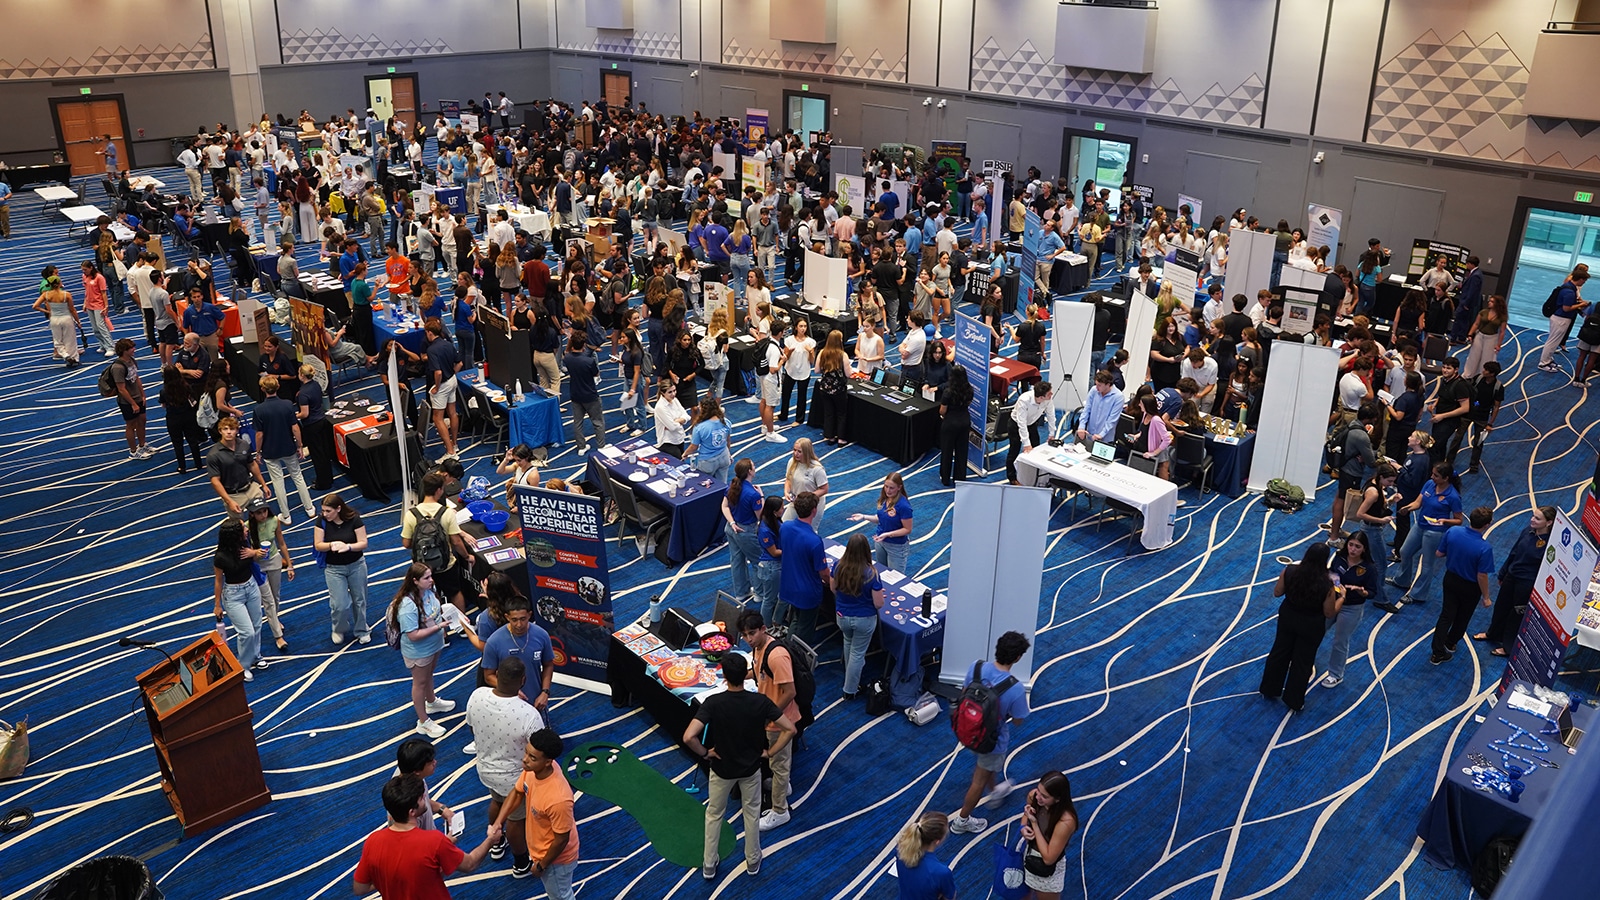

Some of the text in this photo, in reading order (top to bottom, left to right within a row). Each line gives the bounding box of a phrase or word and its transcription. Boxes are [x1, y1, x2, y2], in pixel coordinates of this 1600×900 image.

[1133, 184, 1153, 193] FLORIDA
[448, 196, 458, 205] UF
[1576, 192, 1591, 202] EXIT
[964, 328, 986, 343] Brigades
[1082, 464, 1148, 491] TAMID GROUP
[520, 494, 596, 514] HEAVENER
[522, 506, 596, 524] SECOND-YEAR
[523, 514, 598, 534] EXPERIENCE
[910, 614, 939, 628] UF
